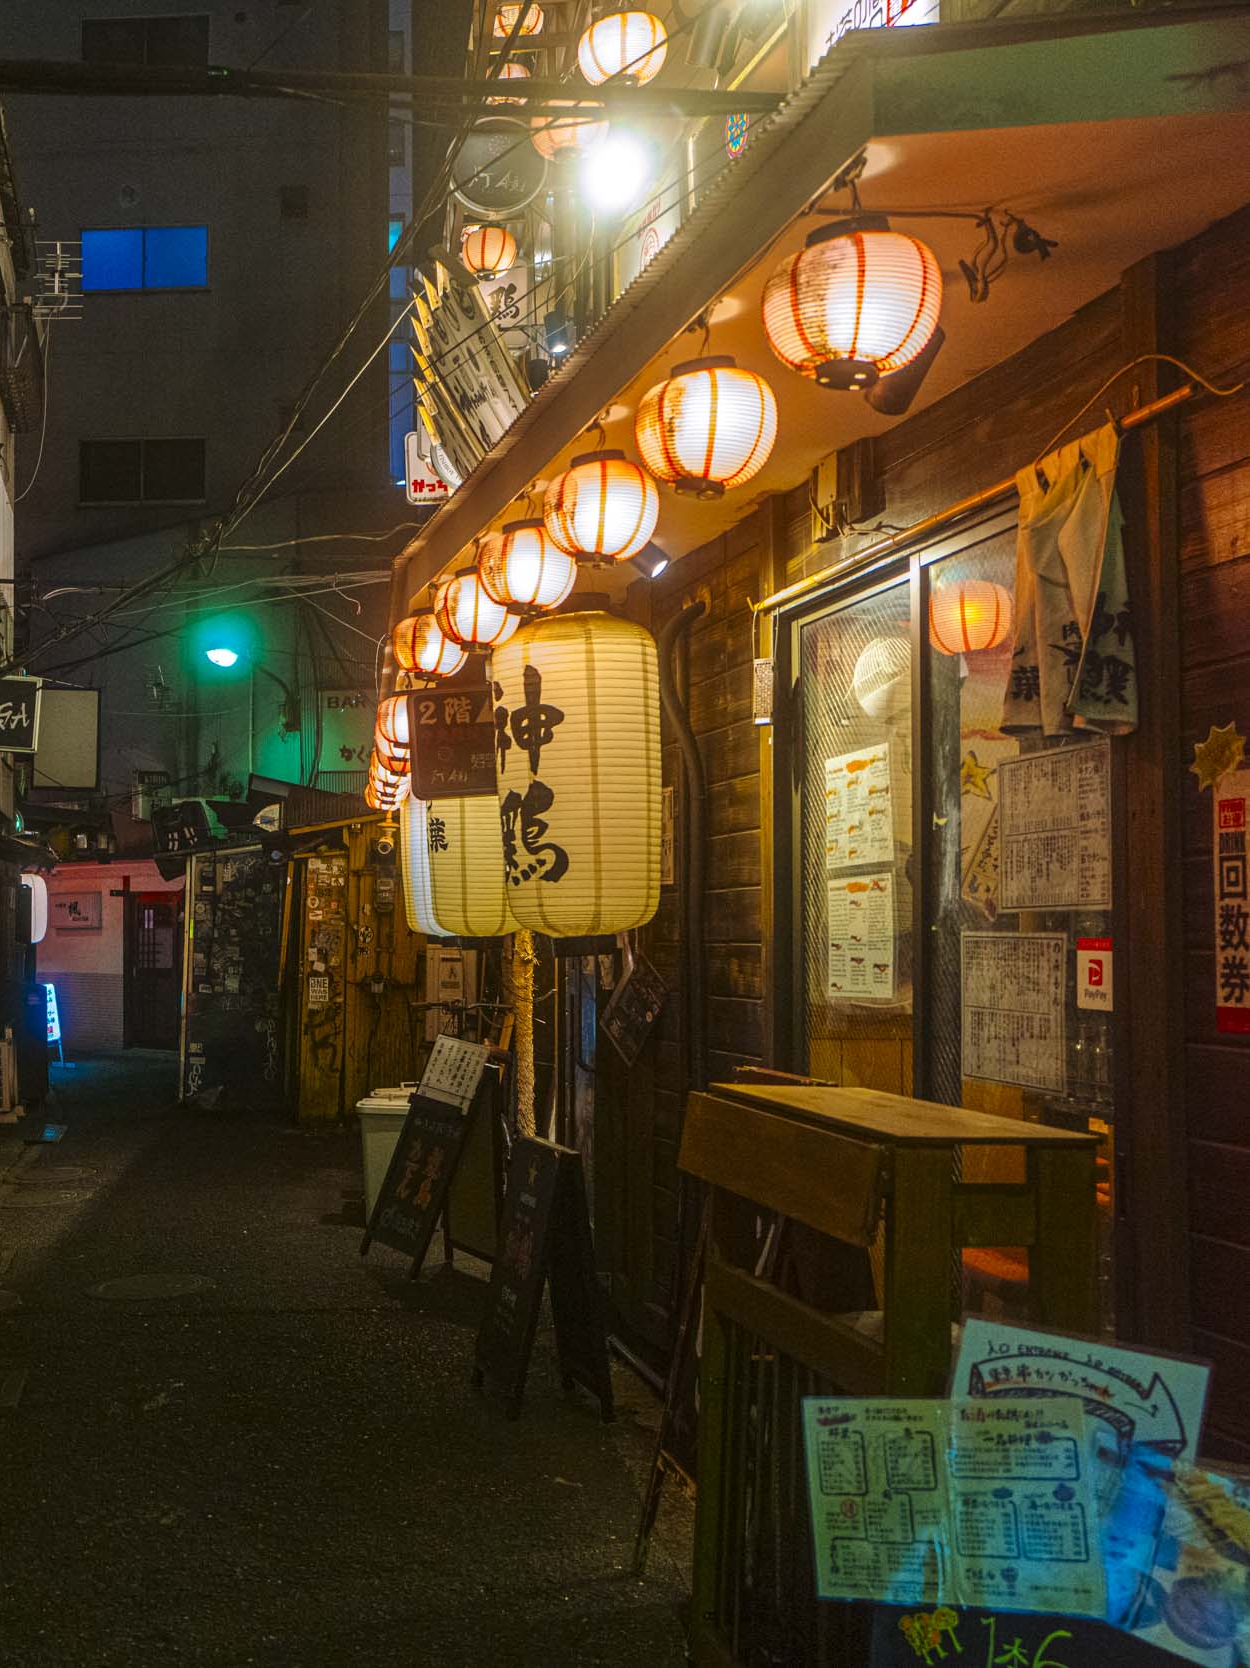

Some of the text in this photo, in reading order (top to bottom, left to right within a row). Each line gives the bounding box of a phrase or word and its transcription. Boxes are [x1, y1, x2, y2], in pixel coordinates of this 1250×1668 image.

[327, 696, 365, 710] BAR
[418, 696, 472, 727] 2階
[1220, 856, 1248, 1004] 回数券
[1085, 988, 1107, 1002] PayPay
